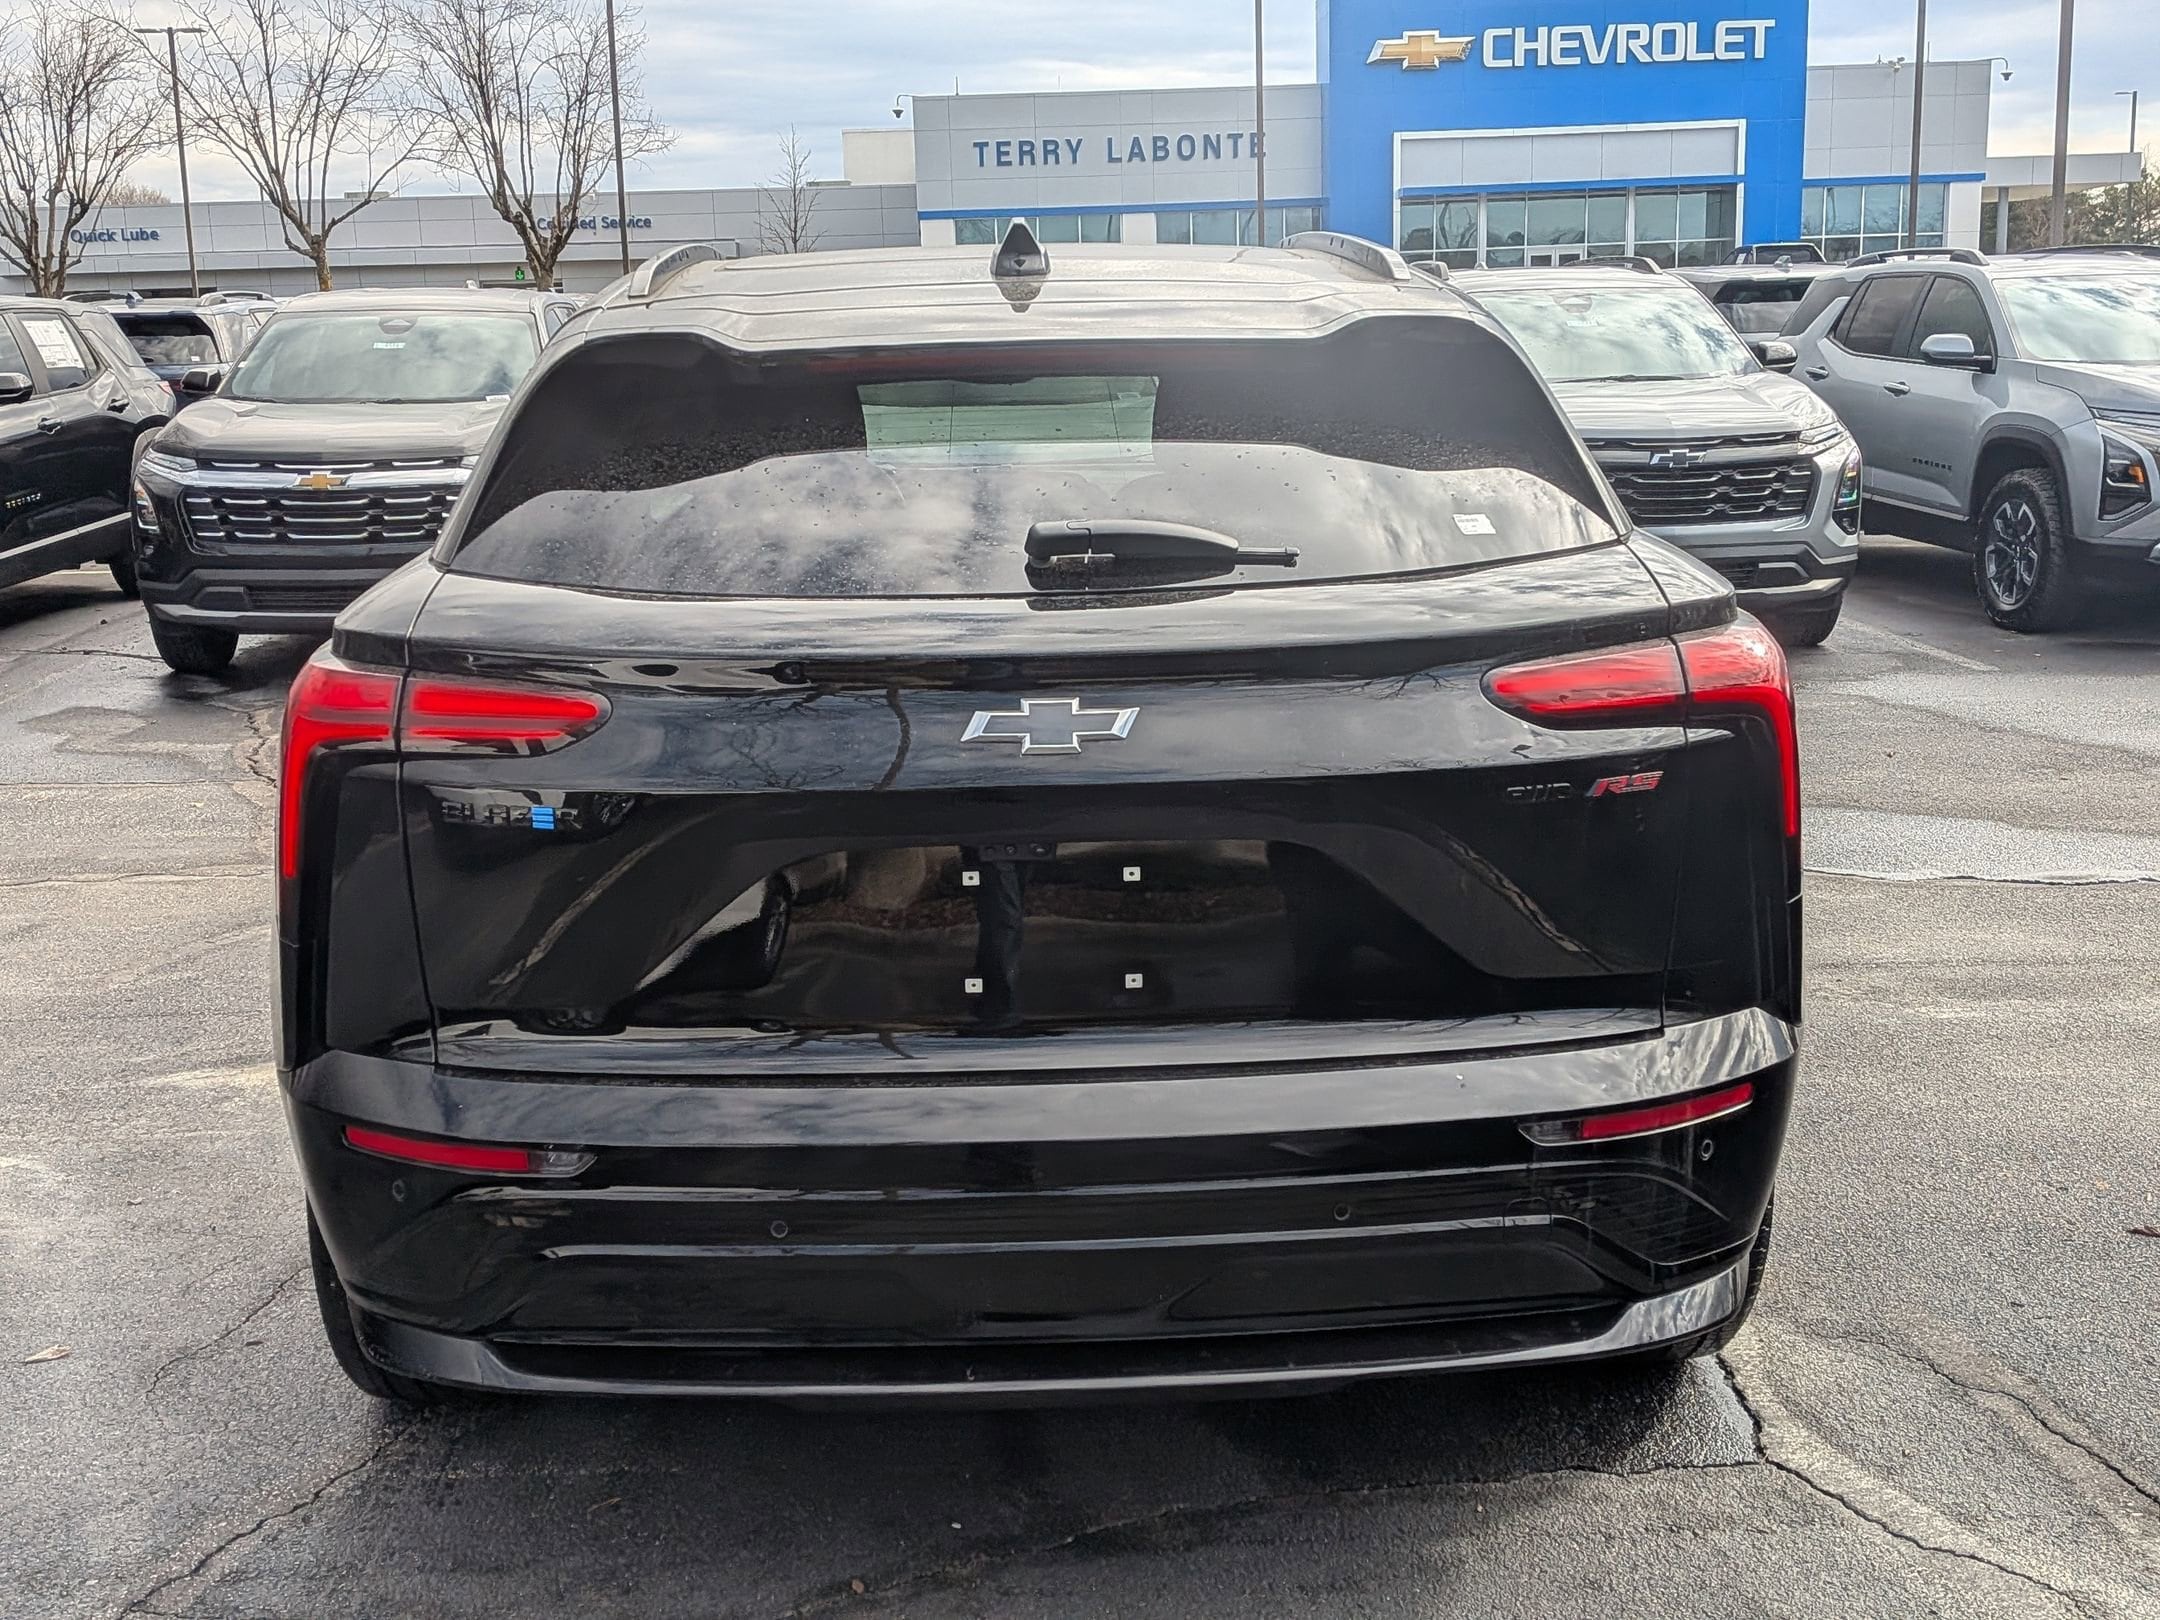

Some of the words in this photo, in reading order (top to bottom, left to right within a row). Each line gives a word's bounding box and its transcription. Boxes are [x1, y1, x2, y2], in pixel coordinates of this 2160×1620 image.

[1482, 19, 1776, 68] CHEVROLET
[973, 138, 1083, 167] TERRY
[1107, 132, 1266, 163] LABONTE
[601, 215, 652, 229] Sevice
[70, 228, 117, 244] Quick
[120, 227, 160, 241] Lube
[1584, 771, 1664, 797] RS
